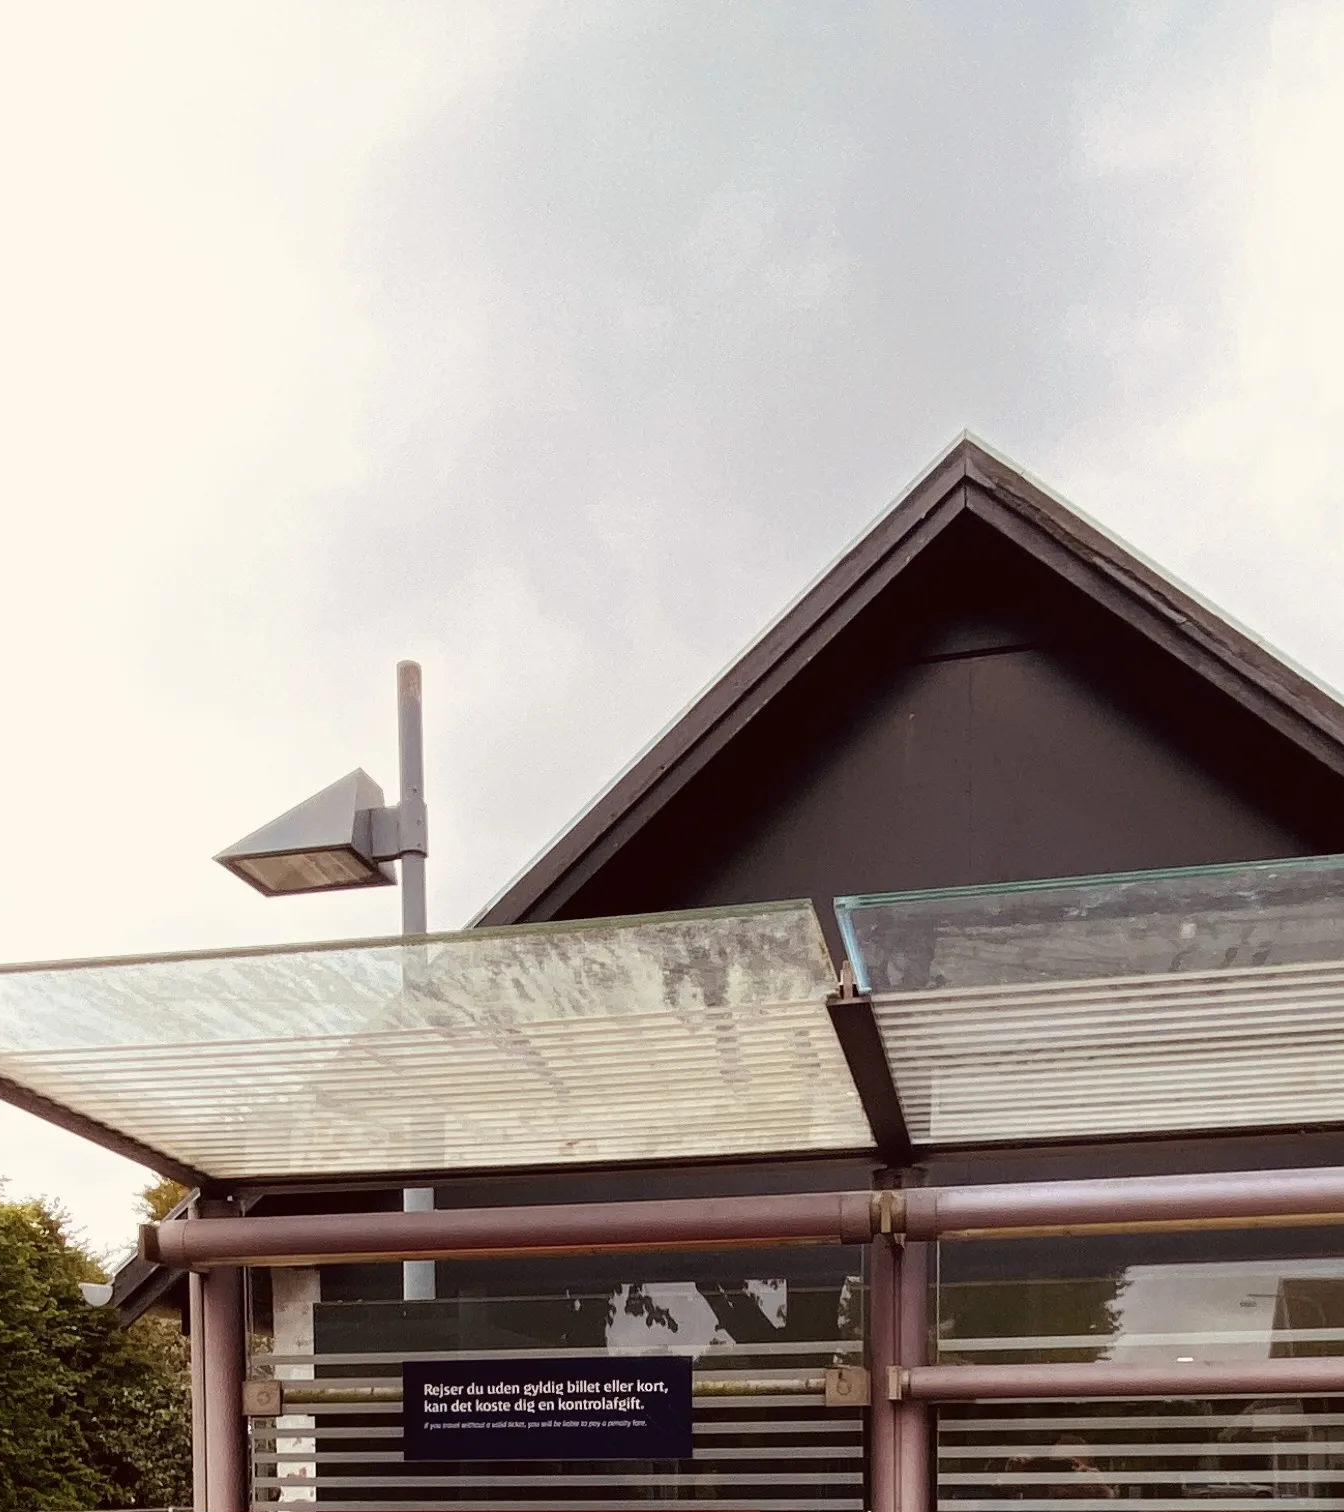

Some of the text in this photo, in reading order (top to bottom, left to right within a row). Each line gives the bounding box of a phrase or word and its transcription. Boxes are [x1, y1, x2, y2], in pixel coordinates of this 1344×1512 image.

[424, 1380, 669, 1398] Rejser du uden gyldig billet eller kort,
[424, 1397, 645, 1413] kan det koste dig en kontrolafgift.
